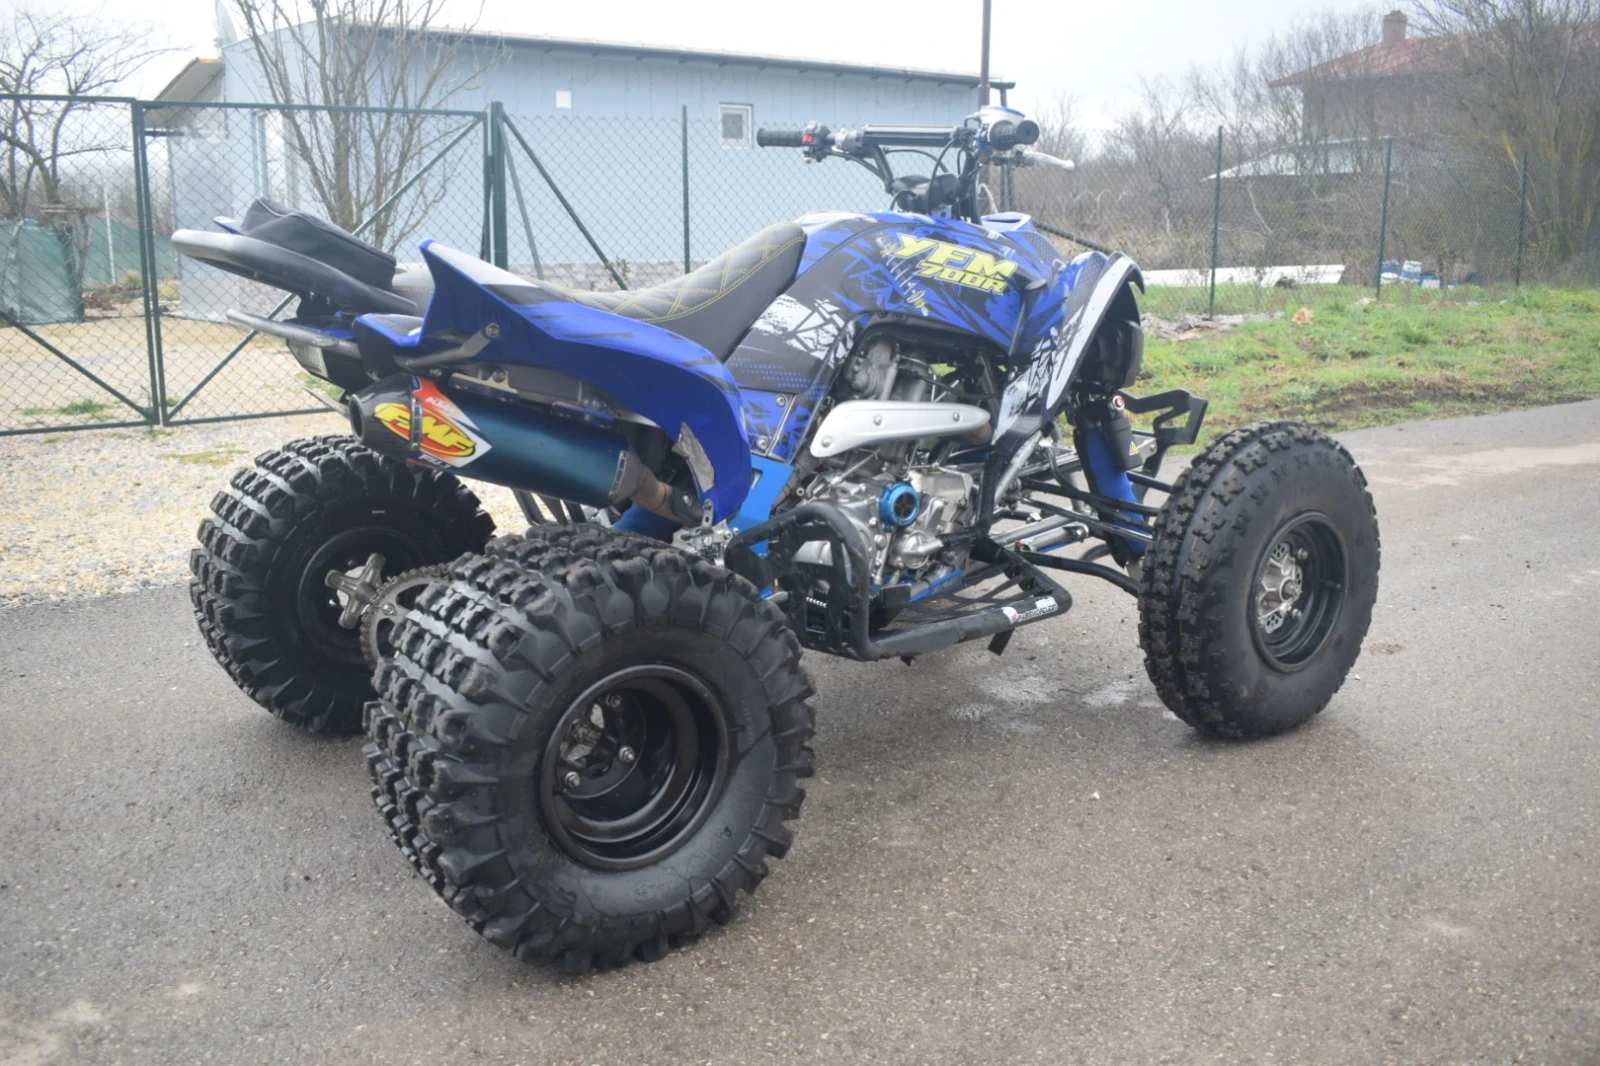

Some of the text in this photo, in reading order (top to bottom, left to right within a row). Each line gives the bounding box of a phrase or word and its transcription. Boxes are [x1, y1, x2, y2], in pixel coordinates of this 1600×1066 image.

[892, 233, 1018, 278] YFM
[915, 261, 1008, 295] 700R
[374, 404, 477, 453] FMF
